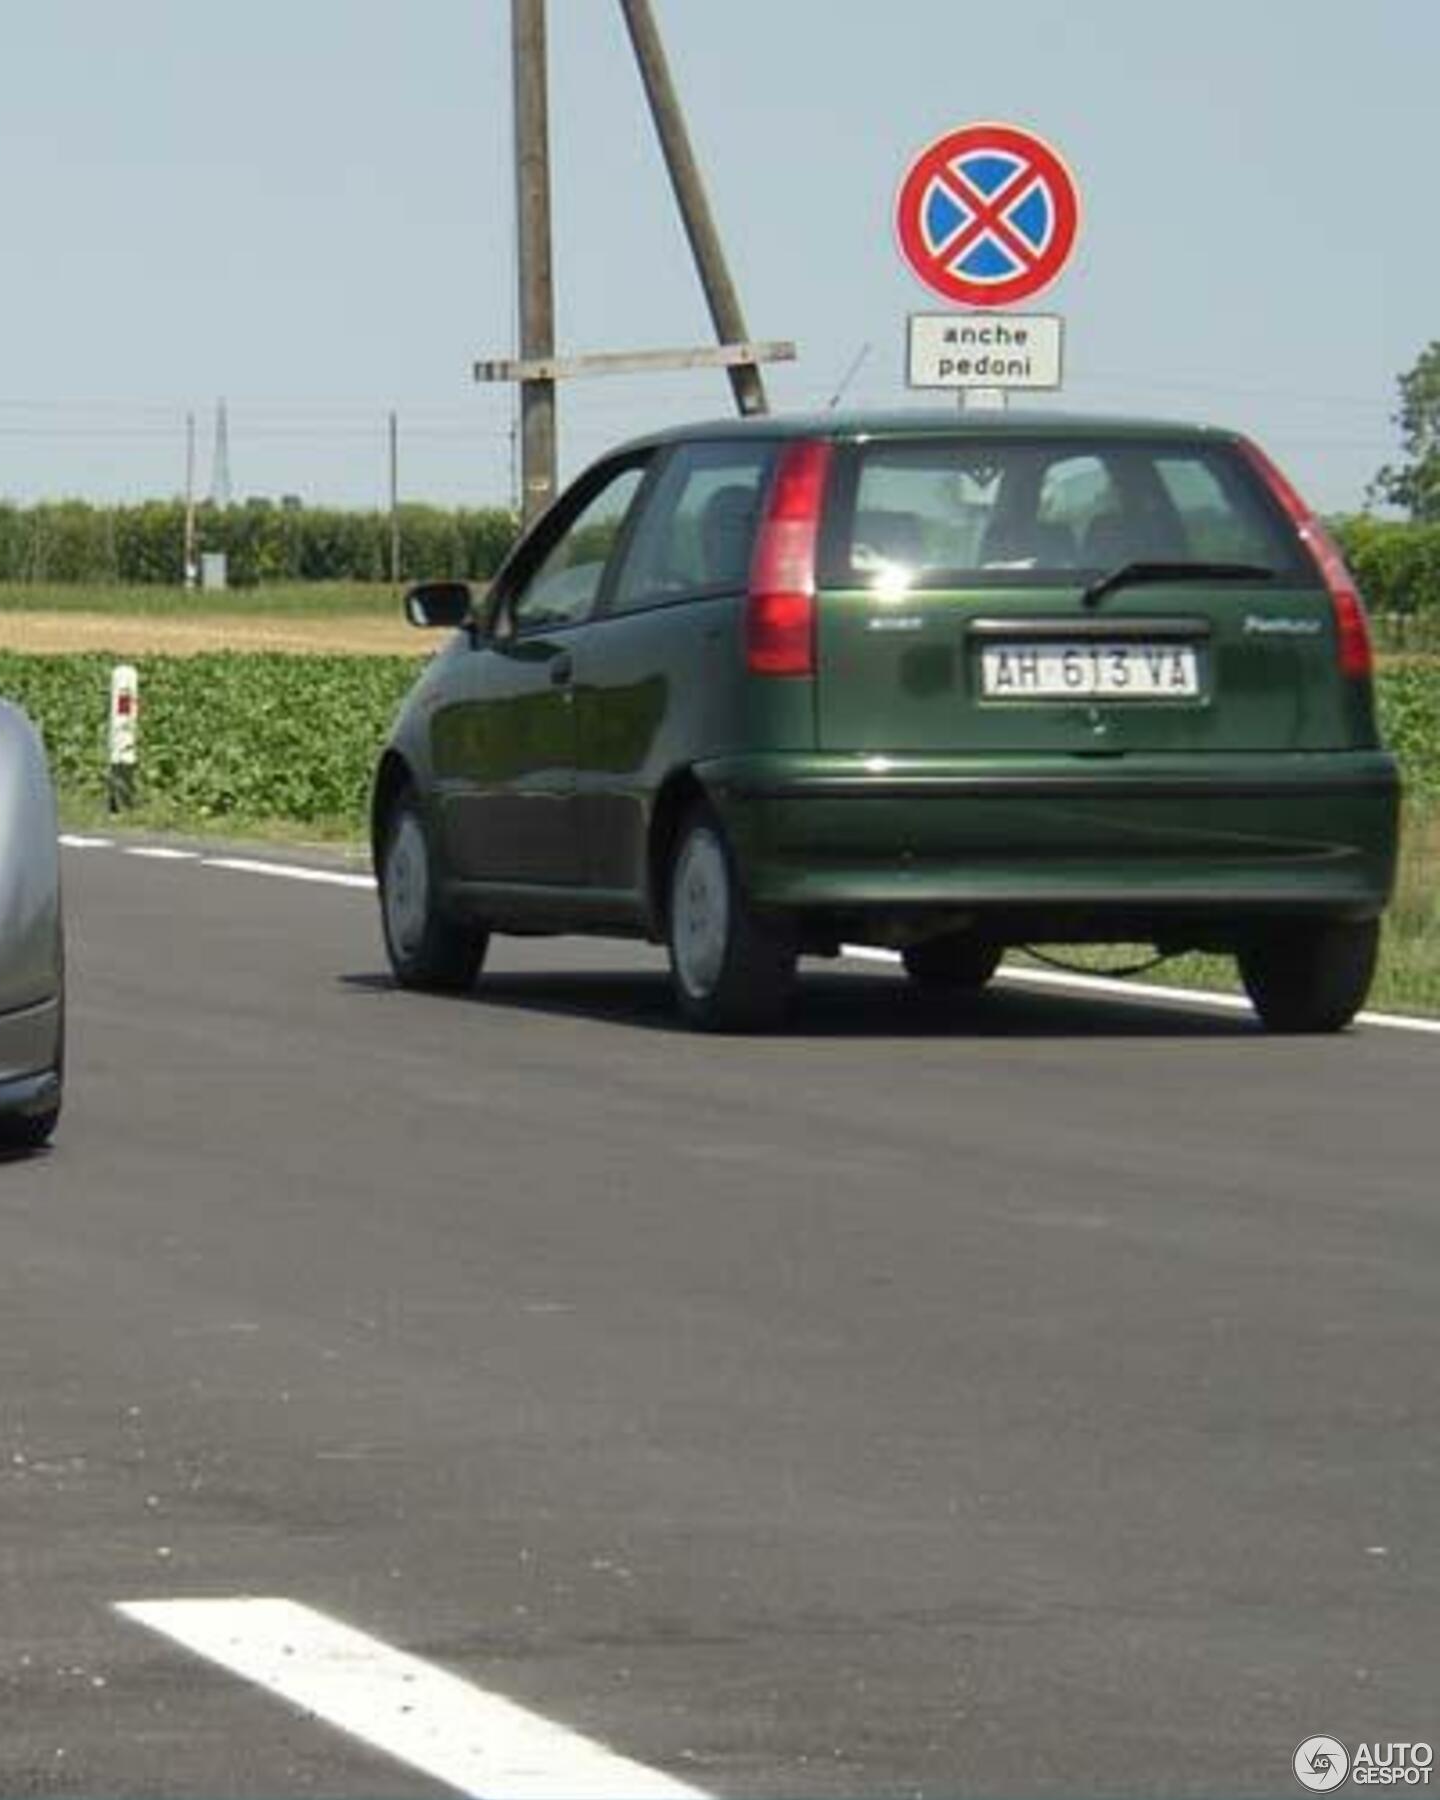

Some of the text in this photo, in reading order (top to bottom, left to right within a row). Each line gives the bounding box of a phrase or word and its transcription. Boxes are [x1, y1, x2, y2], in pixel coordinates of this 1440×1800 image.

[943, 325, 1028, 345] anche
[938, 356, 1031, 378] pedoni
[997, 649, 1186, 688] AH 613 VA
